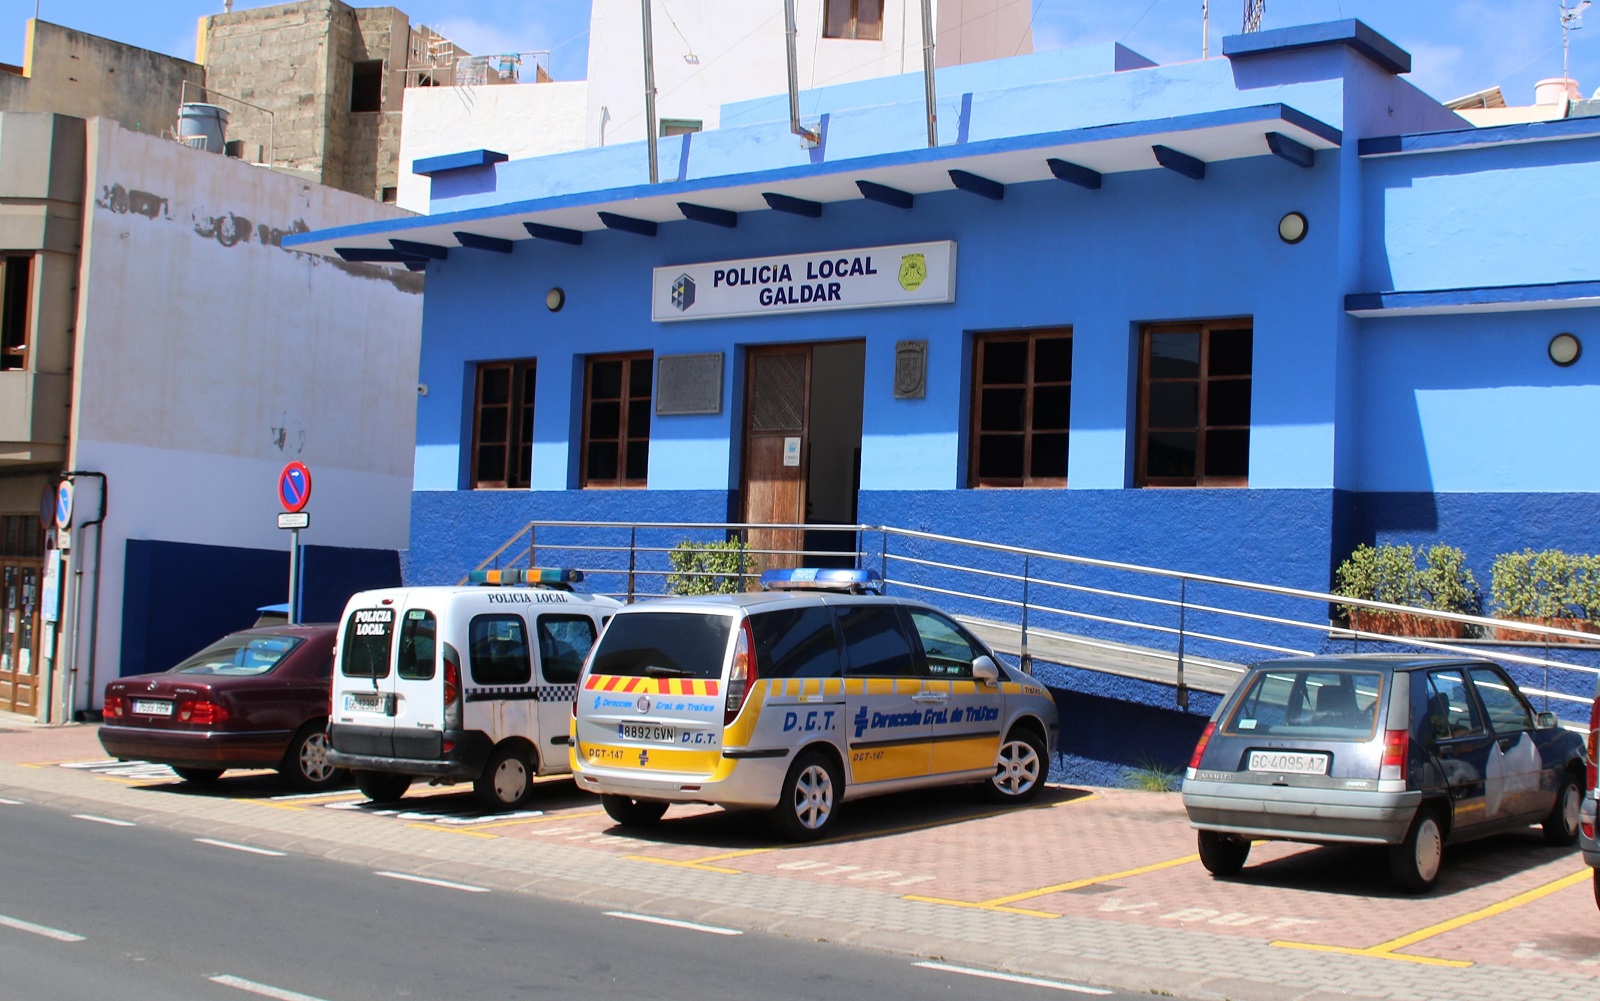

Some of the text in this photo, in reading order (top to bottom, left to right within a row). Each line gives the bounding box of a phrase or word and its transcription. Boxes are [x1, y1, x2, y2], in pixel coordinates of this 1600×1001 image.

[806, 256, 878, 280] LOCAL
[759, 282, 842, 306] GALDAR
[487, 593, 568, 604] POLICIA LOCAL
[355, 610, 392, 623] POLICIA
[356, 623, 385, 636] LOCAL
[783, 710, 836, 732] D.G.T.
[950, 707, 964, 723] de
[624, 726, 674, 740] 8892 GVN
[681, 732, 717, 744] D.G.T.
